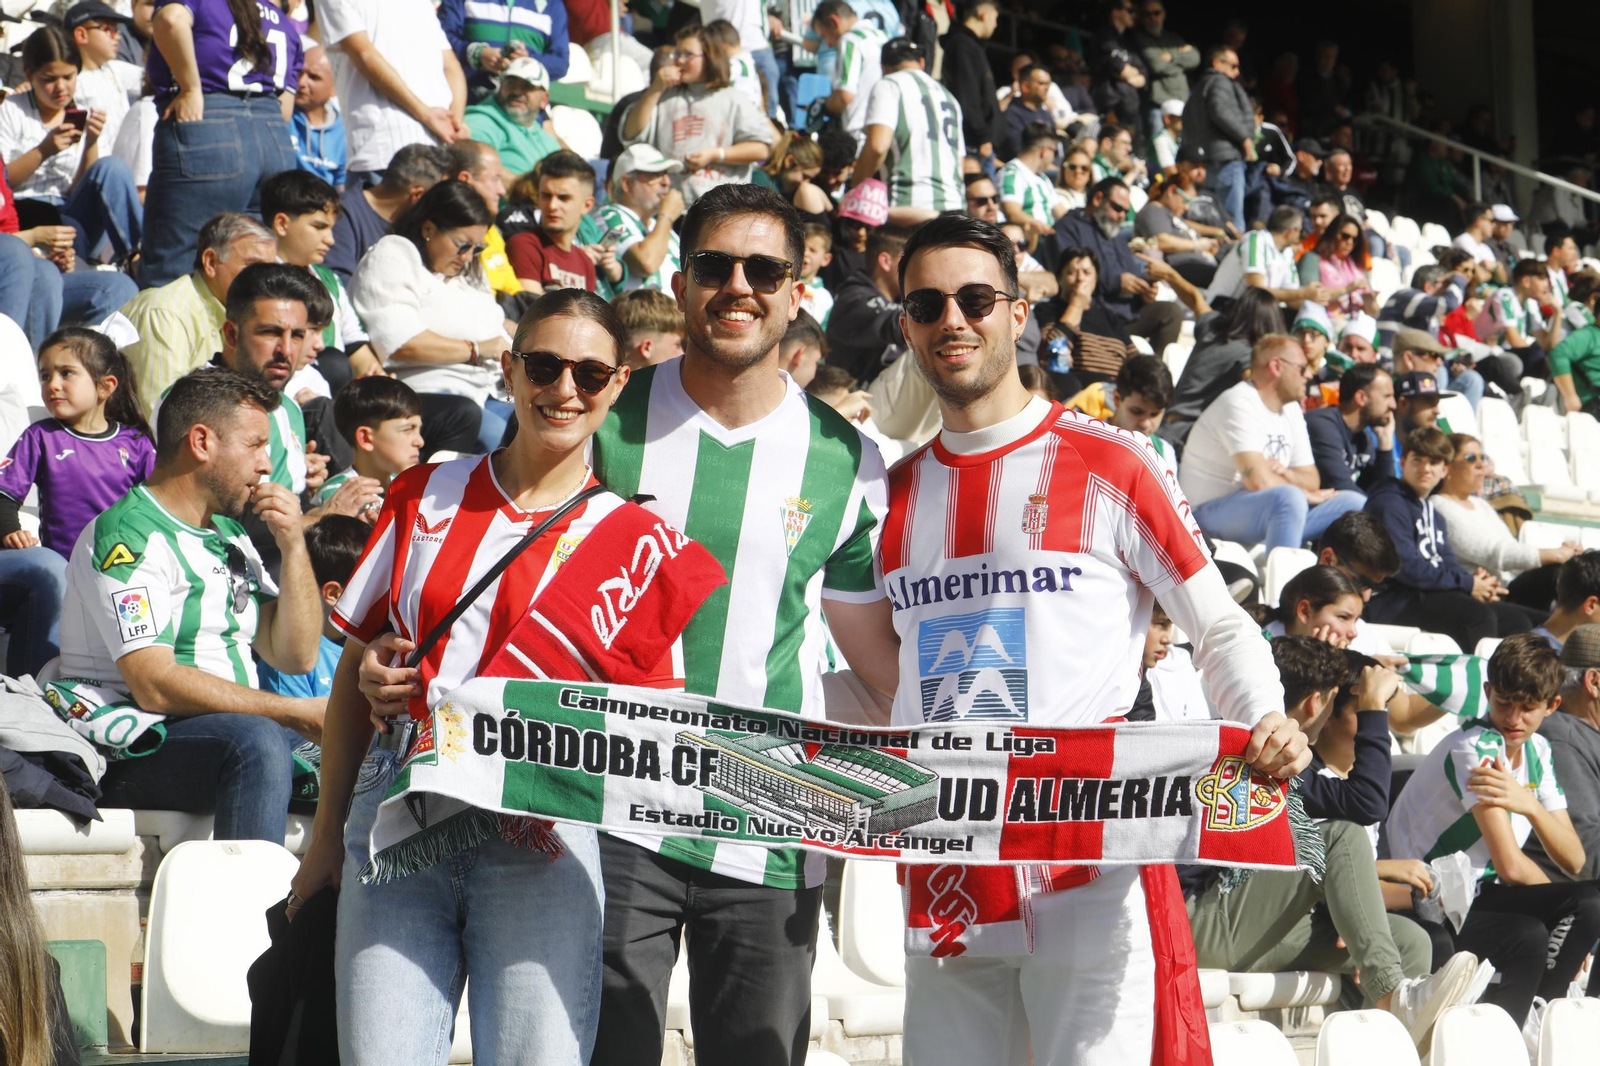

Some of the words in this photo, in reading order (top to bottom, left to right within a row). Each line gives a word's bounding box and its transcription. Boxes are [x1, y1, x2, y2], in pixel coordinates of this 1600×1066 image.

[921, 95, 959, 151] 12
[412, 535, 443, 544] CASTORE
[128, 624, 149, 638] LFP
[560, 688, 767, 735] Campeonato
[777, 717, 919, 750] Nacional
[931, 731, 974, 752] de
[985, 731, 1057, 758] Liga
[472, 710, 662, 781] CÓRDOBA
[671, 746, 720, 788] CF
[937, 776, 1000, 822] UD
[1006, 775, 1194, 823] ALMERIA
[629, 804, 738, 834] Estadio
[747, 815, 836, 842] Nuevo
[847, 830, 974, 853] Arcángel
